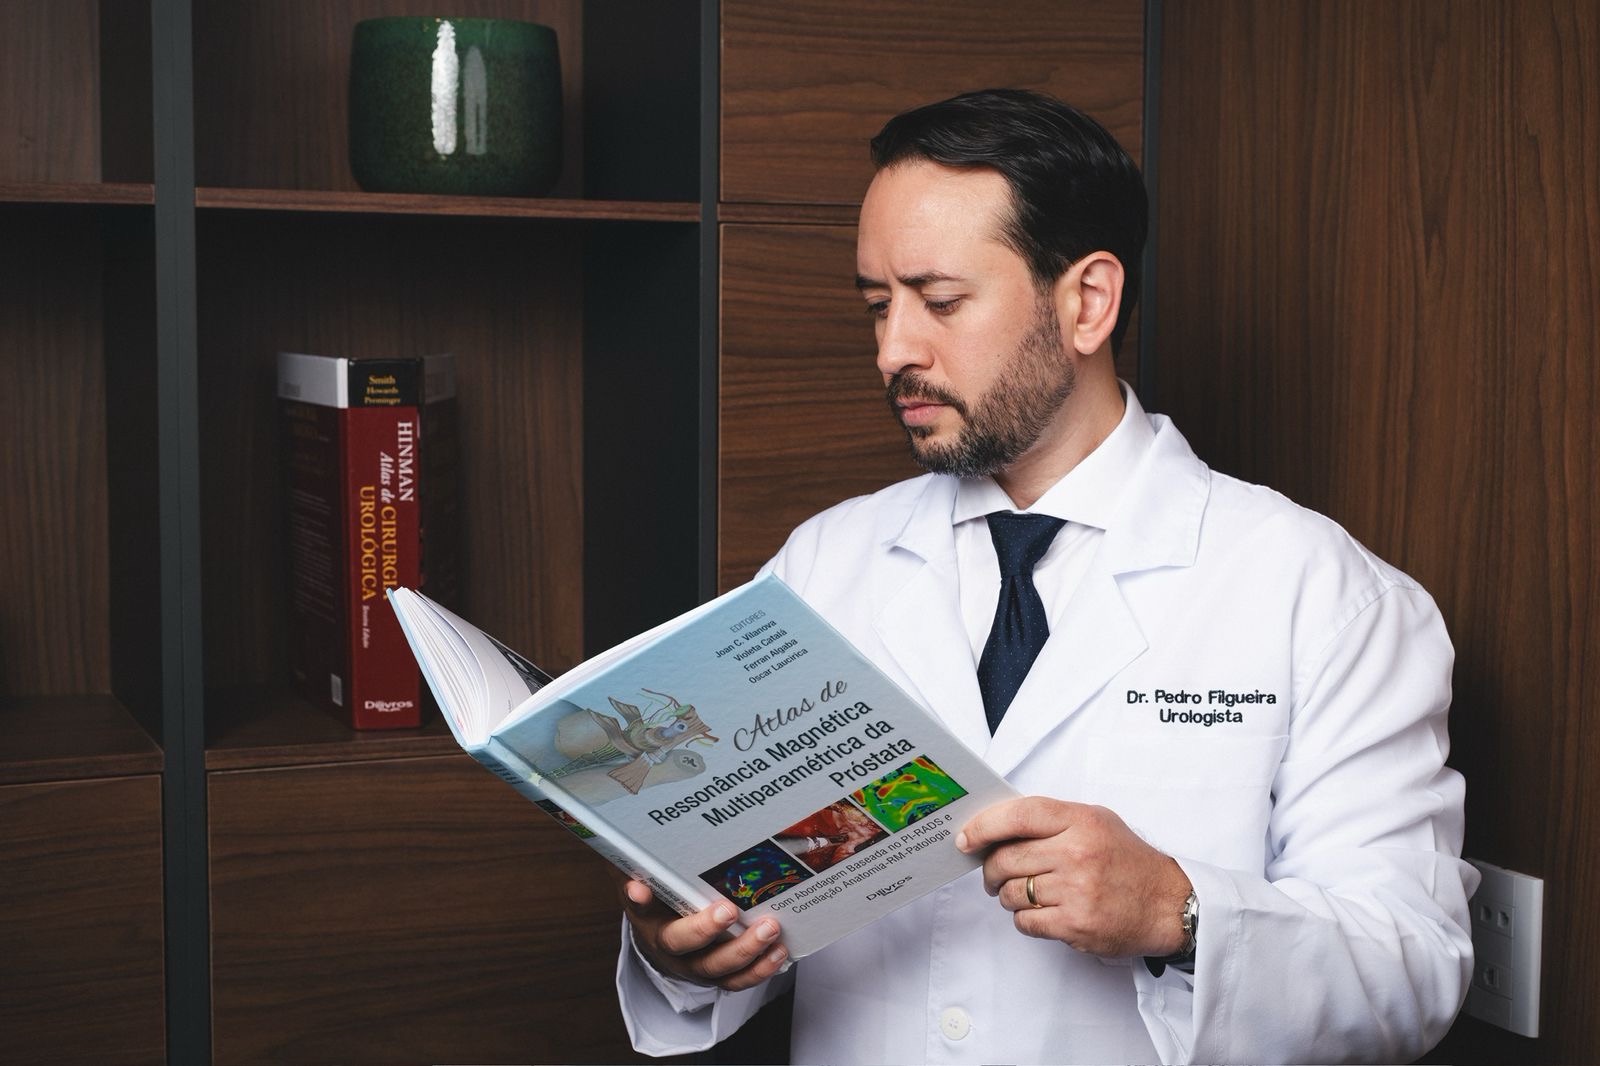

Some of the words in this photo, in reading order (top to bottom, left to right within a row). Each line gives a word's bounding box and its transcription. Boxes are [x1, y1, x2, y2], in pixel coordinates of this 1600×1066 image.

[368, 375, 396, 385] Smith
[380, 452, 395, 485] Atlas
[398, 422, 413, 501] HINMAN
[381, 489, 395, 504] de
[360, 486, 377, 600] UROLÓGICA
[715, 643, 736, 659] Joan
[741, 619, 777, 642] Vilanova
[729, 609, 767, 633] EDITORES
[733, 643, 763, 662] Violeta
[760, 628, 788, 648] Catalá
[743, 654, 772, 672] Ferran
[769, 637, 799, 659] Algaba
[748, 667, 773, 684] Oscar
[771, 647, 809, 671] Laucirica
[733, 698, 815, 752] Atlas
[820, 680, 848, 703] de
[1126, 690, 1149, 704] Dr.
[1154, 689, 1202, 704] Pedro
[1208, 689, 1277, 707] Filgueira
[1159, 708, 1243, 727] Urologista
[647, 757, 771, 826] Ressonância
[765, 701, 873, 763] Magnética
[700, 736, 866, 827] Multiparamétrica
[864, 720, 895, 740] da
[828, 738, 916, 788] Próstata
[770, 896, 797, 912] Com
[794, 869, 848, 898] Abordagem
[845, 847, 889, 873] Baseada
[887, 842, 903, 853] no
[902, 817, 945, 845] PI-RADS
[944, 813, 954, 822] e
[791, 885, 844, 914] Correlação
[844, 828, 952, 888] Anatomia-RM-Patologia
